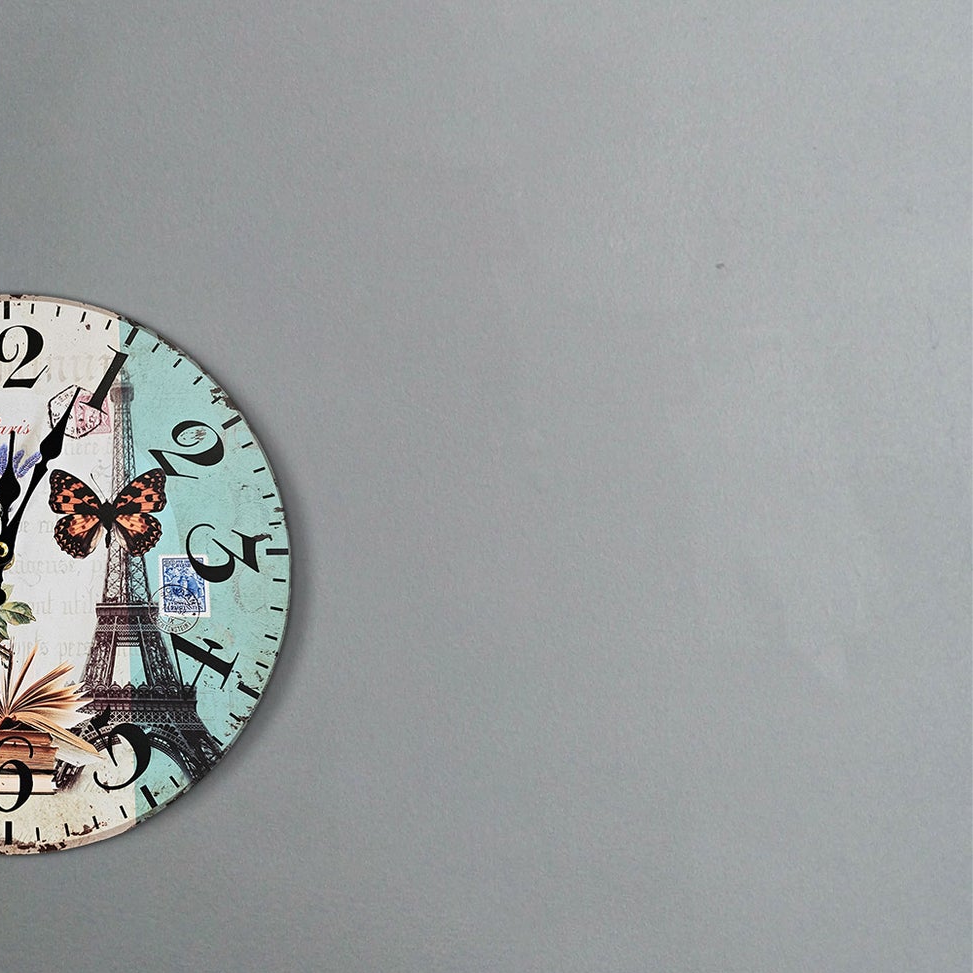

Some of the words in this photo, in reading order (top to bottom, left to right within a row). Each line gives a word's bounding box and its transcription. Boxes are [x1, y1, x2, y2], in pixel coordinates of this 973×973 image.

[80, 344, 129, 416] 1
[146, 419, 225, 481] 2
[185, 523, 274, 583] 3
[171, 632, 242, 690] 4
[93, 704, 152, 791] 5
